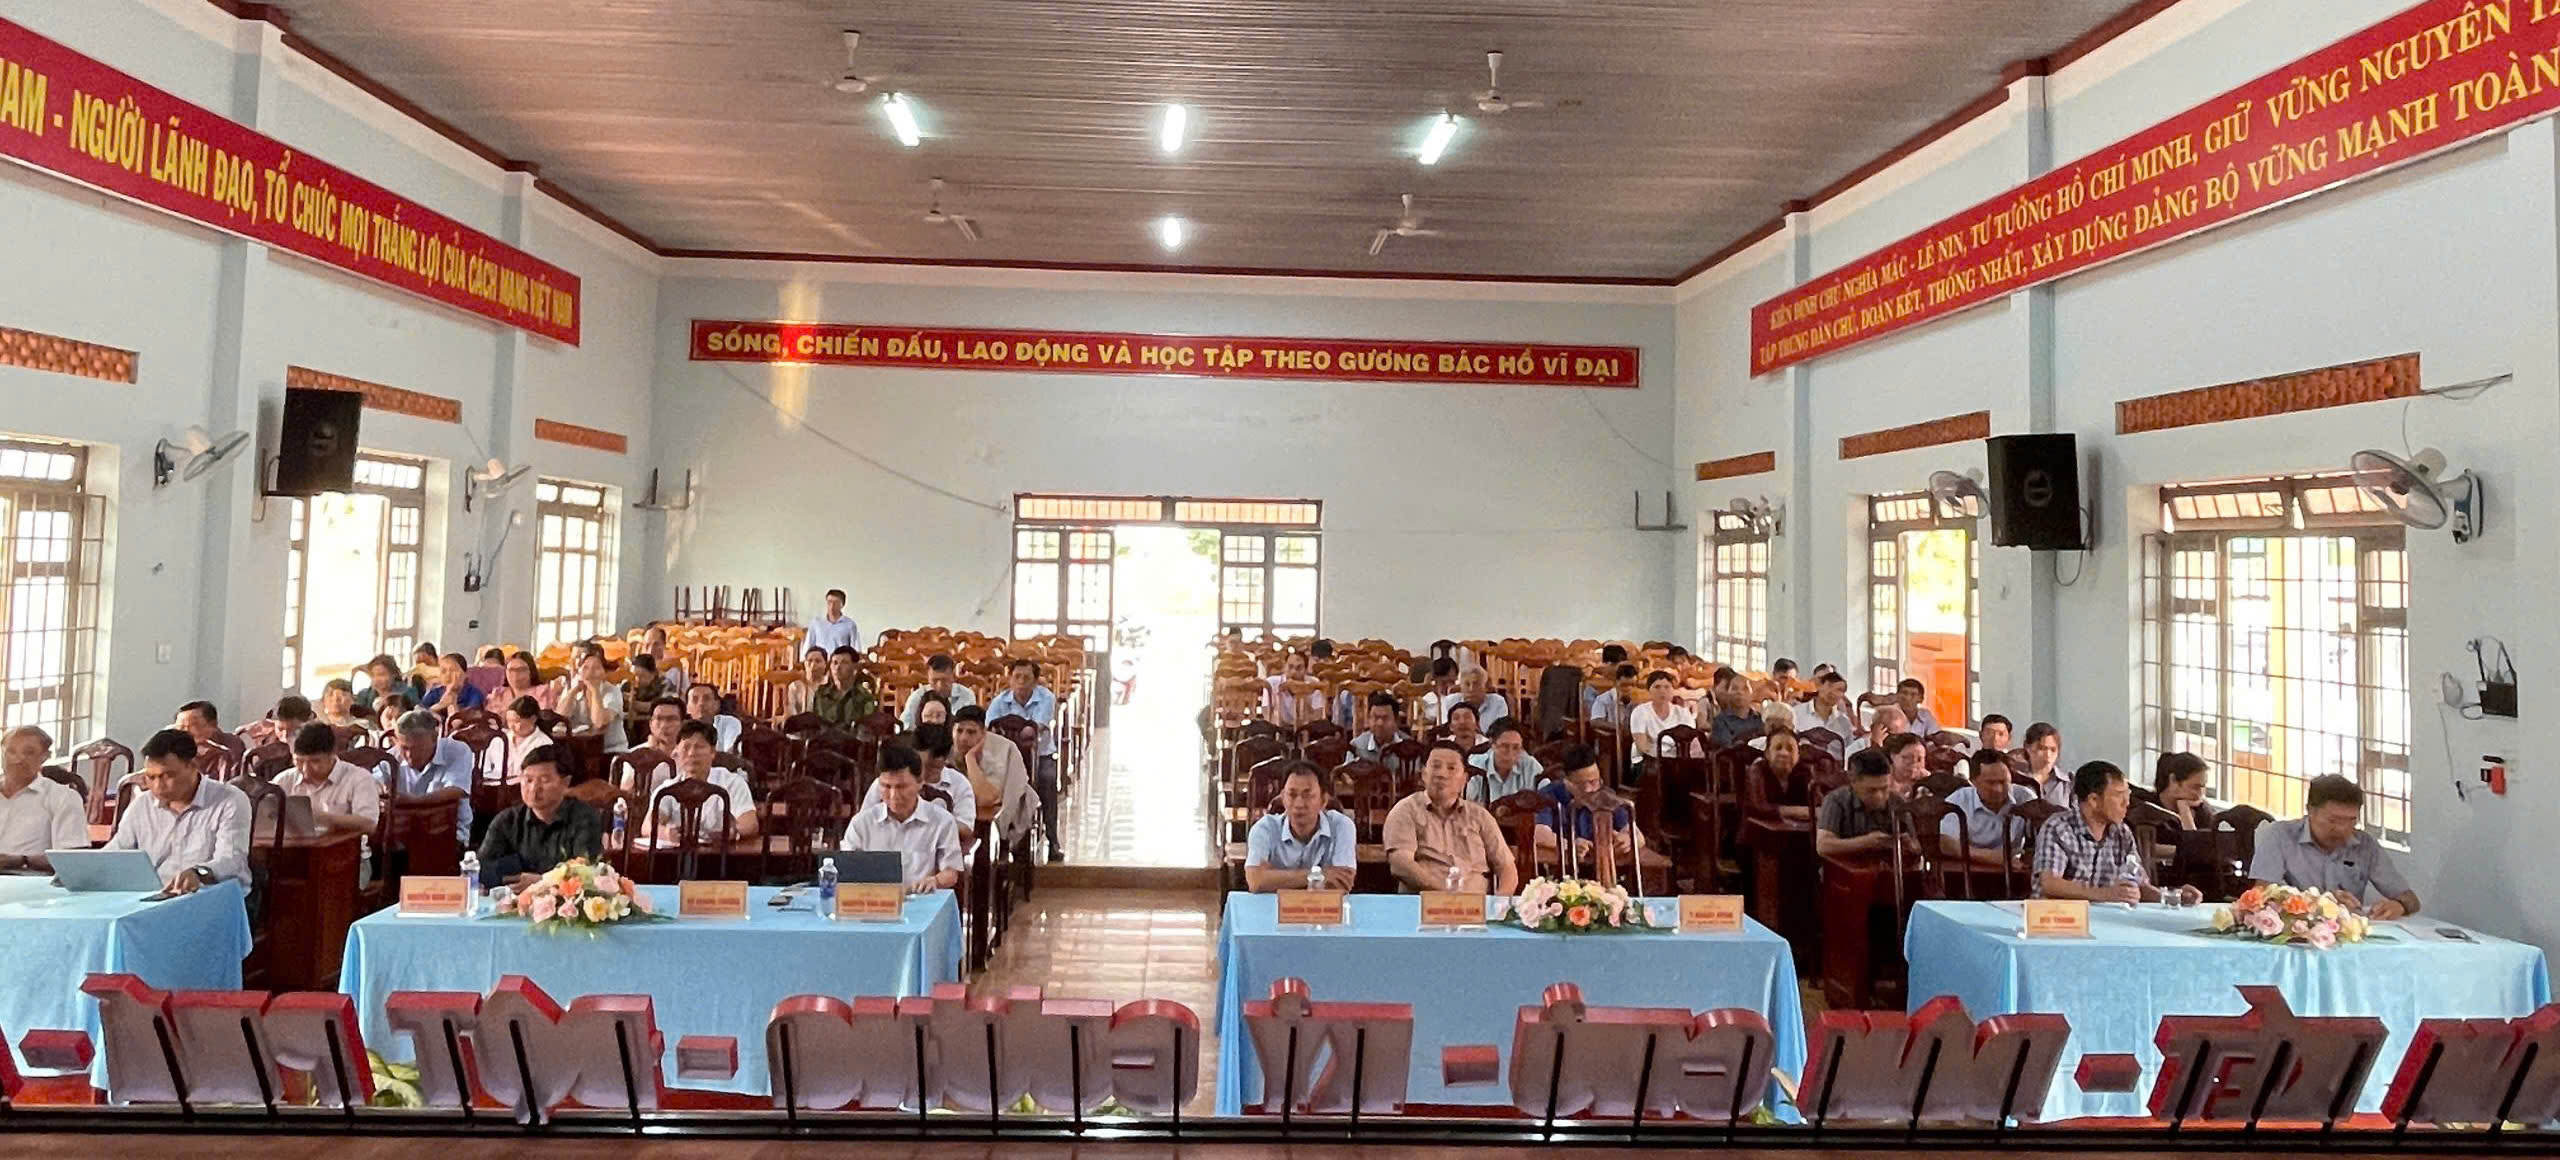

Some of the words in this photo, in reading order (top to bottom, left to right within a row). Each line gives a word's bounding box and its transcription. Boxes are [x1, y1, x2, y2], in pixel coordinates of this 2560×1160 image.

[0, 57, 48, 136] AM
[53, 114, 63, 127] -
[70, 89, 146, 174] NGƯỜI
[151, 115, 209, 197] LÃNH
[213, 148, 258, 225] ĐẠO,
[264, 150, 291, 224] TỔ
[292, 179, 337, 242] CHỨC
[339, 200, 369, 262] MỌI
[373, 203, 417, 272] THẮNG
[419, 232, 441, 288] LỢI
[443, 231, 466, 290] CỦA
[468, 247, 498, 300] CÁCH
[1861, 298, 1894, 330] ĐOÀN
[1896, 281, 1926, 319] KẾT,
[1928, 263, 1976, 307] THỐNG
[1979, 241, 2028, 289] NHẤT,
[2031, 231, 2066, 270] XÂY
[2071, 212, 2128, 257] DỰNG
[2134, 185, 2198, 235] ĐẢNG
[2205, 161, 2240, 209] BỘ
[2248, 135, 2328, 193] VỮNG
[2337, 92, 2440, 159] MẠNH
[2450, 46, 2560, 121] TOÀN
[1917, 237, 1936, 271] LÊ
[1938, 231, 1967, 263] NIN,
[1971, 213, 1993, 249] TƯ
[1994, 194, 2052, 239] TƯỞNG
[2057, 166, 2085, 215] HỒ
[2090, 153, 2127, 201] CHÍ
[2131, 133, 2198, 185] MINH,
[2205, 99, 2252, 153] GIỮ
[2267, 65, 2351, 128] VỮNG
[2360, 0, 2511, 92] NGUYÊN
[707, 326, 789, 359] SỐNG,
[796, 329, 879, 357] CHIẾN
[887, 331, 949, 362] ĐẤU,
[957, 340, 1009, 360] LAO
[1015, 338, 1089, 367] ĐỘNG
[1098, 339, 1132, 364] VÀ
[1141, 345, 1195, 371] HỌC
[1203, 344, 1254, 372] TẬP
[1261, 349, 1331, 370] THEO
[1338, 348, 1430, 373] GƯƠNG
[1438, 348, 1491, 374] BÁC
[1543, 352, 1568, 376] VĨ
[1575, 358, 1619, 383] ĐẠI
